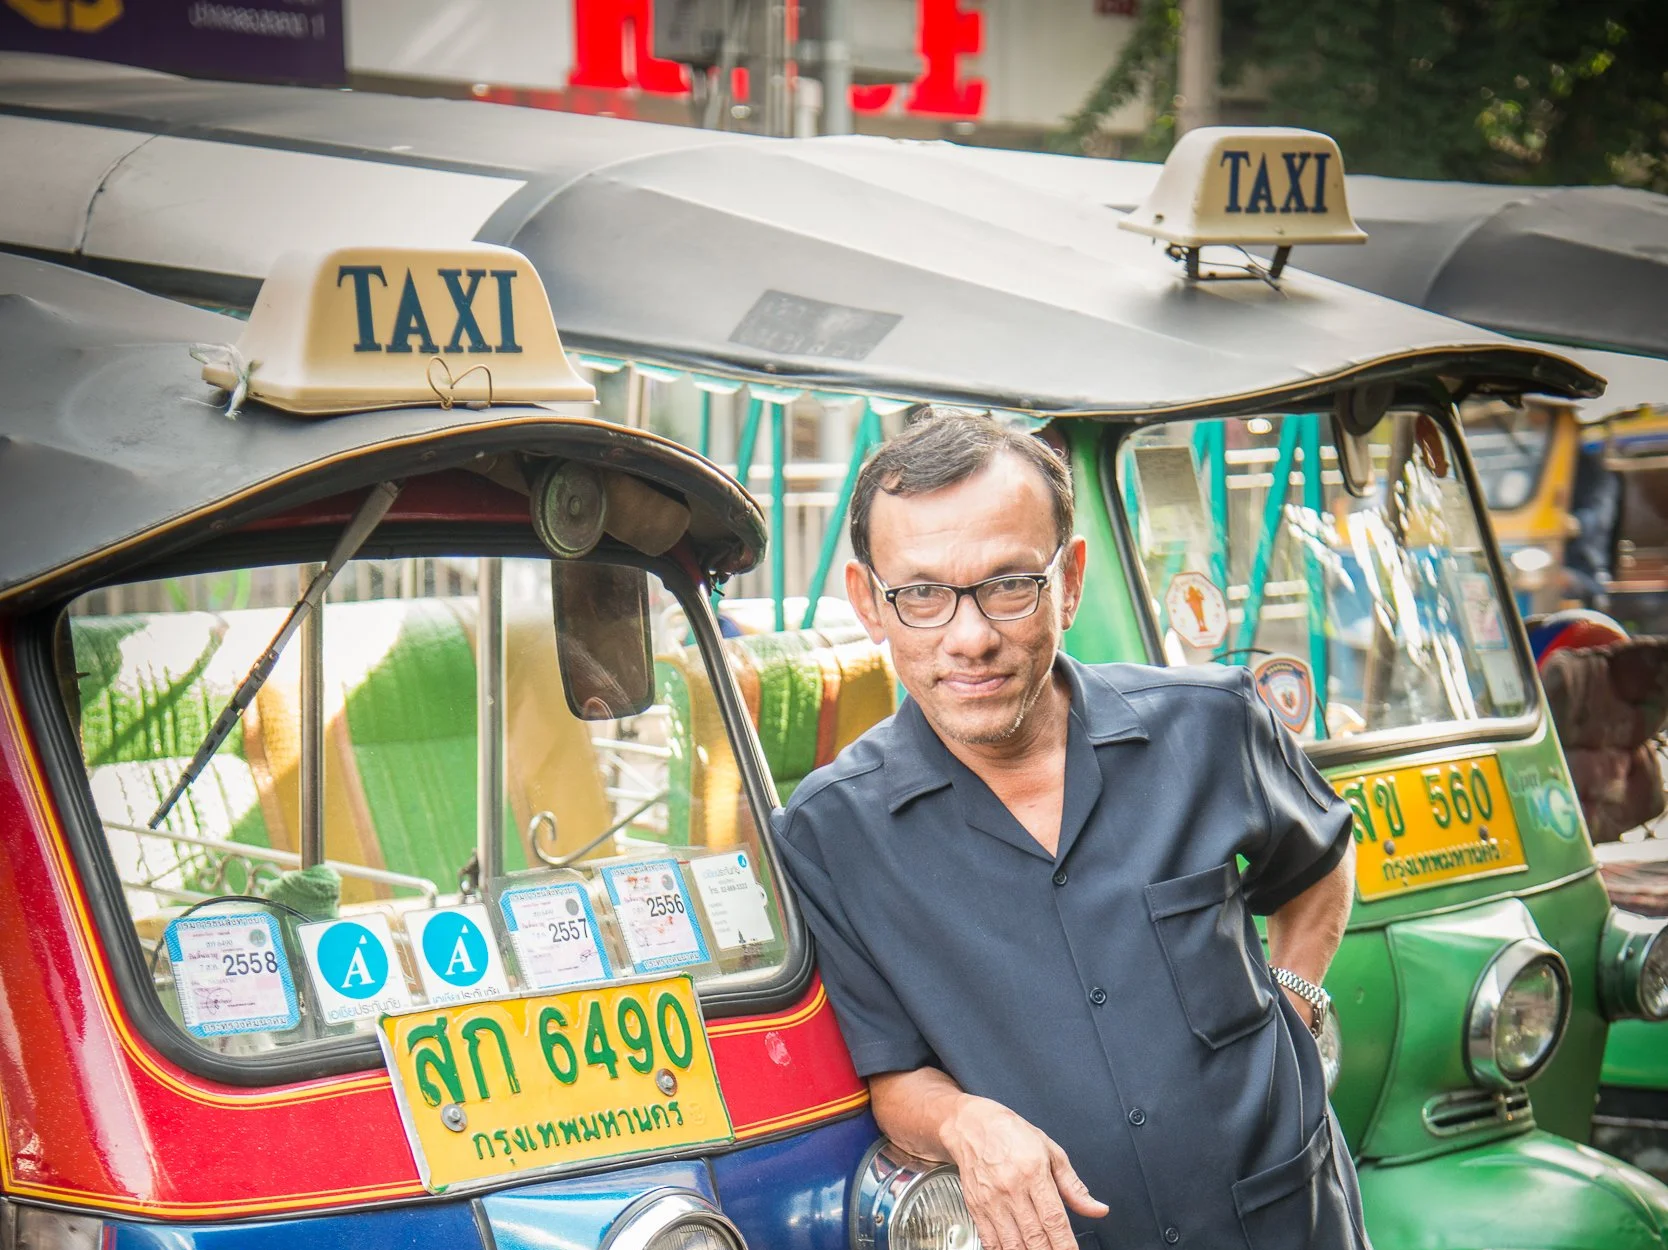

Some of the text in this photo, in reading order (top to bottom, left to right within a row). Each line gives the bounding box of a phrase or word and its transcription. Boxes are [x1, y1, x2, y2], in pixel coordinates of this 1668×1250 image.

[1220, 151, 1331, 213] TAXI
[337, 265, 523, 354] TAXI
[1421, 761, 1493, 829] 560
[1382, 838, 1500, 886] กรุงเทพมหานคร
[548, 917, 588, 943] 2557
[646, 893, 684, 917] 2556
[222, 950, 278, 976] 2558
[406, 991, 694, 1107] สก 6490
[472, 1100, 683, 1166] กรุงเทพมหานคร
